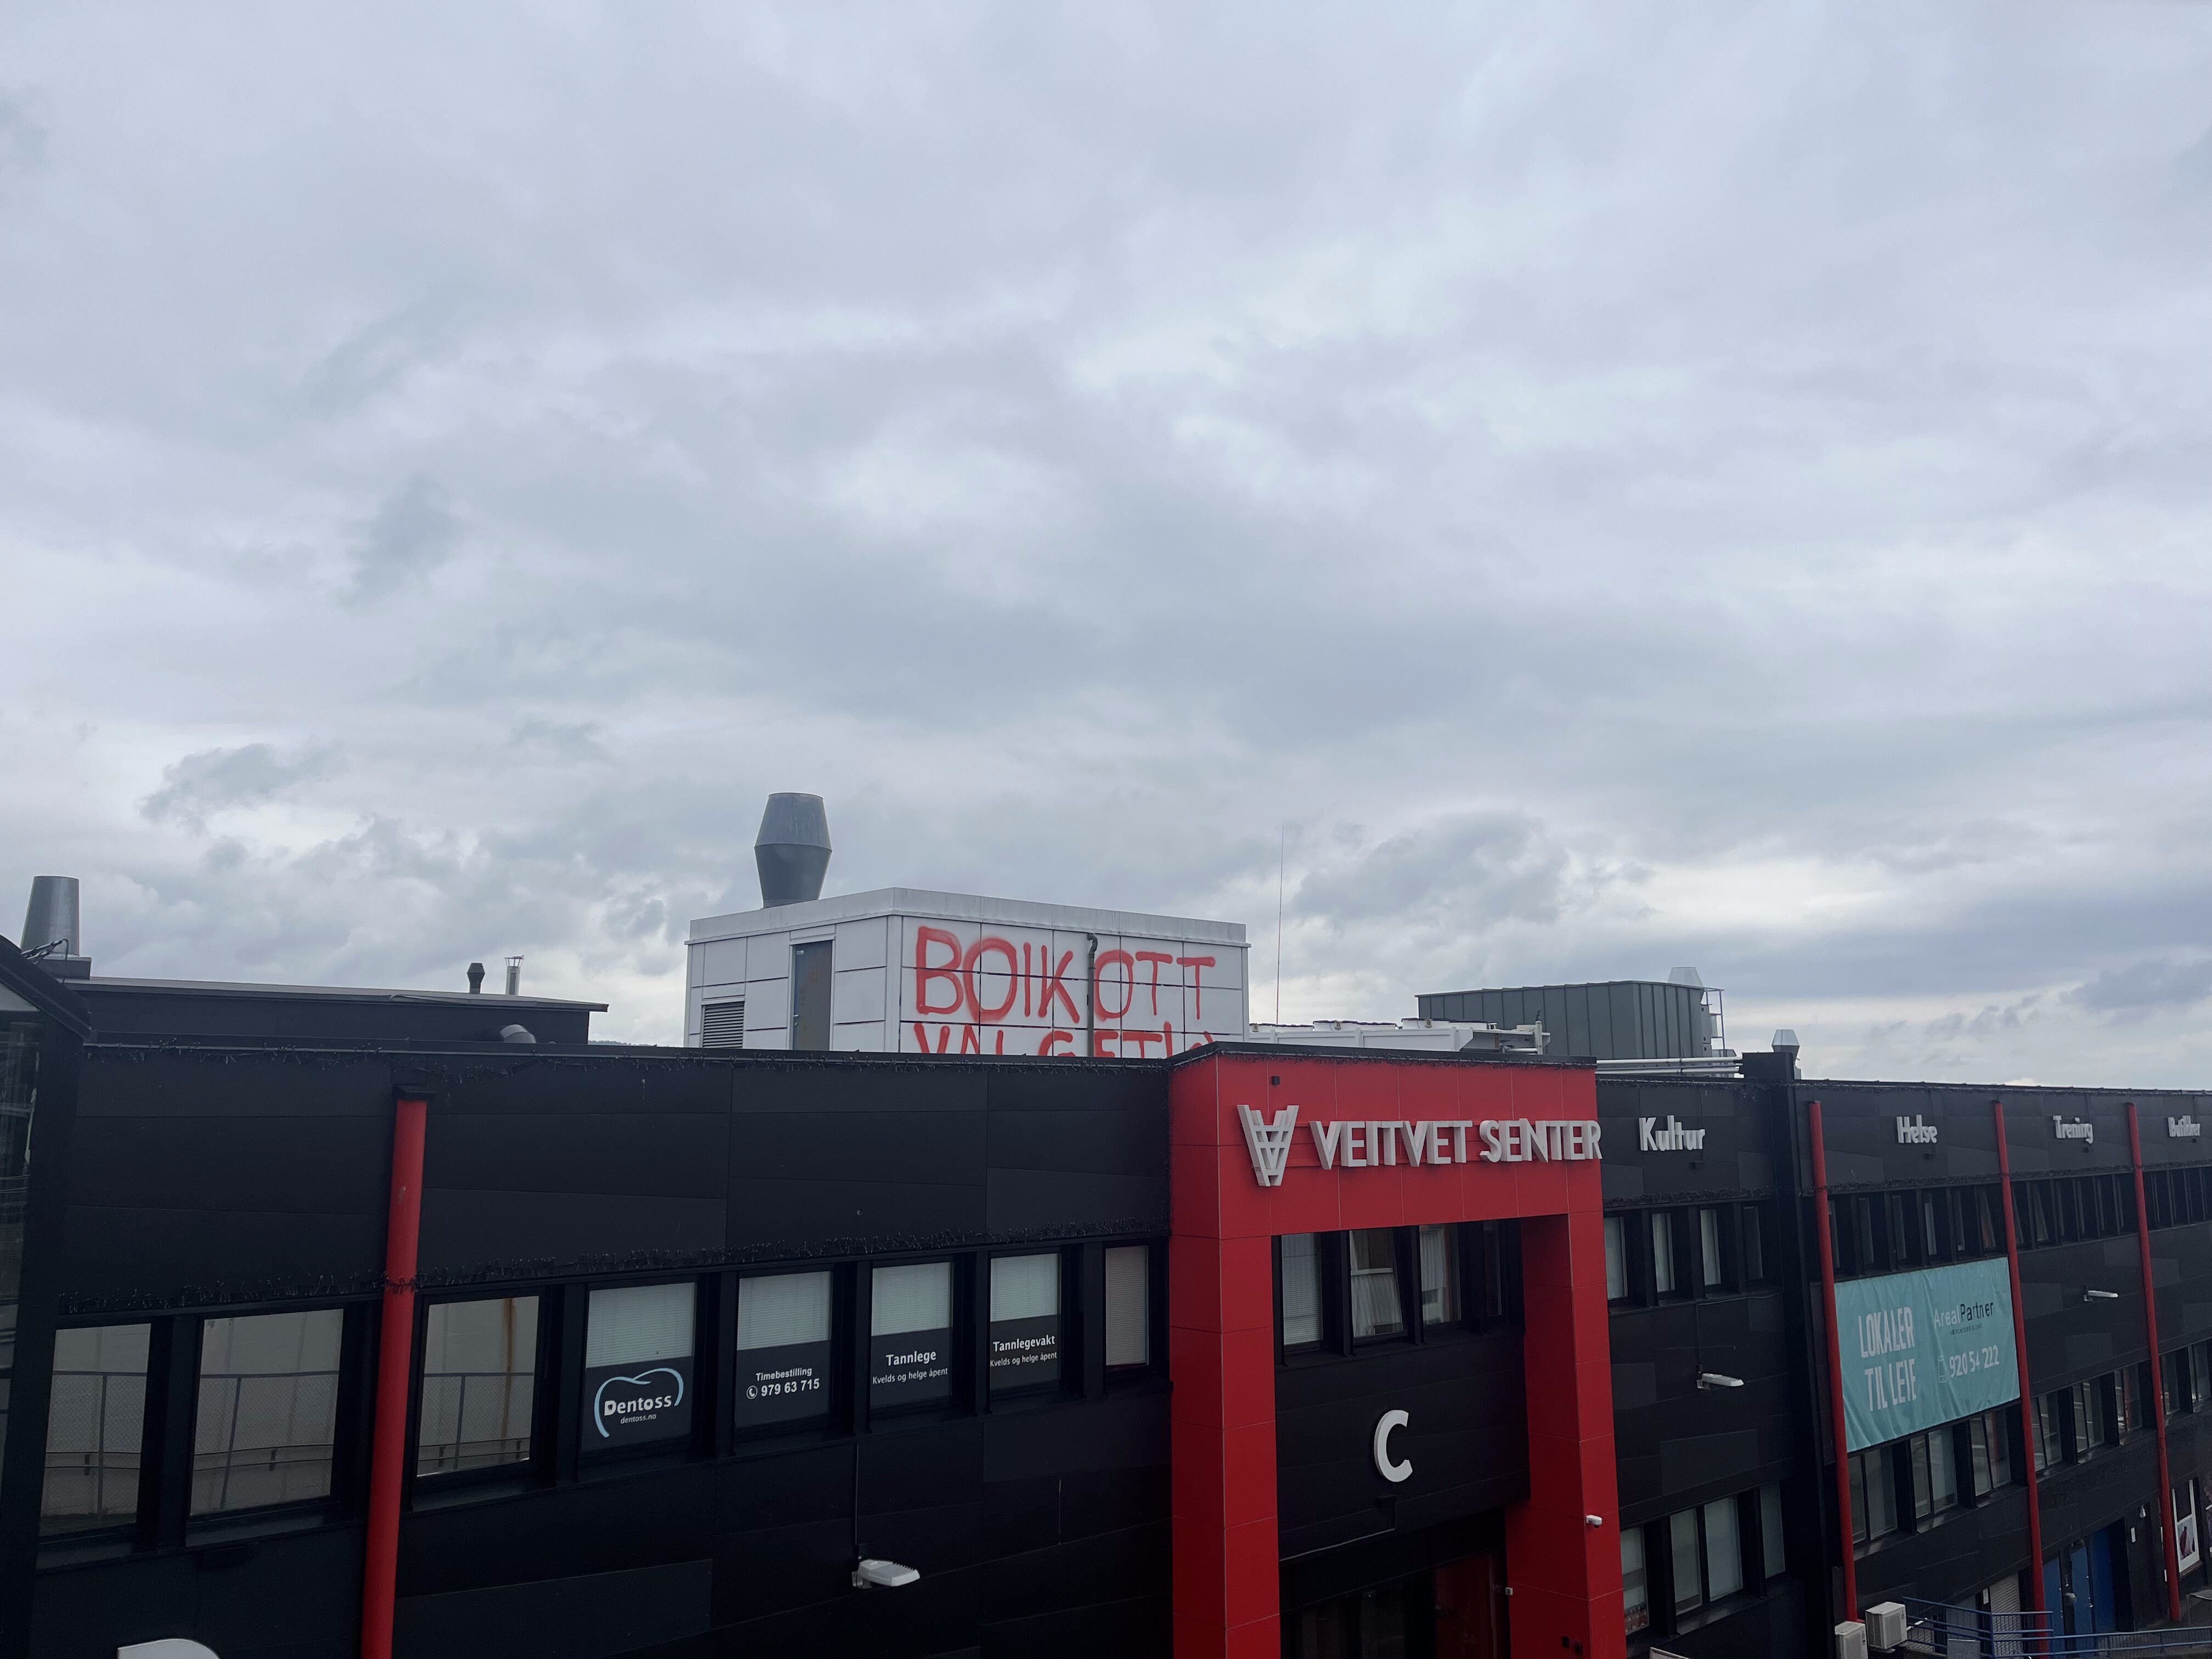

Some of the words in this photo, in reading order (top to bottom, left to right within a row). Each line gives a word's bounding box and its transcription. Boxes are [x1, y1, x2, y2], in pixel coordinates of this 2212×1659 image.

[916, 926, 1216, 1024] BOIKOTT
[1639, 1115, 1706, 1152] Kultur
[1896, 1114, 1938, 1143] Helse
[1309, 1120, 1473, 1170] VEITVET
[1479, 1118, 1602, 1163] SENTER
[992, 1334, 1056, 1352] Tannlegevakt
[1858, 1307, 1915, 1358] LOKALER
[885, 1350, 937, 1366] Tannlege
[990, 1357, 1011, 1368] Kvelds
[1012, 1357, 1020, 1365] og
[1022, 1354, 1039, 1363] helge
[1040, 1352, 1058, 1362] åpent
[1949, 1352, 1968, 1378] 920
[1969, 1350, 1980, 1372] 54
[1982, 1345, 2000, 1369] 222
[755, 1367, 812, 1381] Timebestilling
[872, 1373, 895, 1385] Kvelds
[897, 1373, 907, 1383] og
[908, 1370, 927, 1380] helge
[929, 1368, 949, 1378] åpent
[1865, 1365, 1888, 1412] TIL
[1888, 1358, 1917, 1406] LEIE
[761, 1383, 781, 1397] 979
[784, 1381, 797, 1393] 63
[800, 1378, 820, 1391] 715
[604, 1395, 672, 1417] Dentoss
[620, 1413, 657, 1425] dentoss.no
[1373, 1409, 1413, 1482] C
